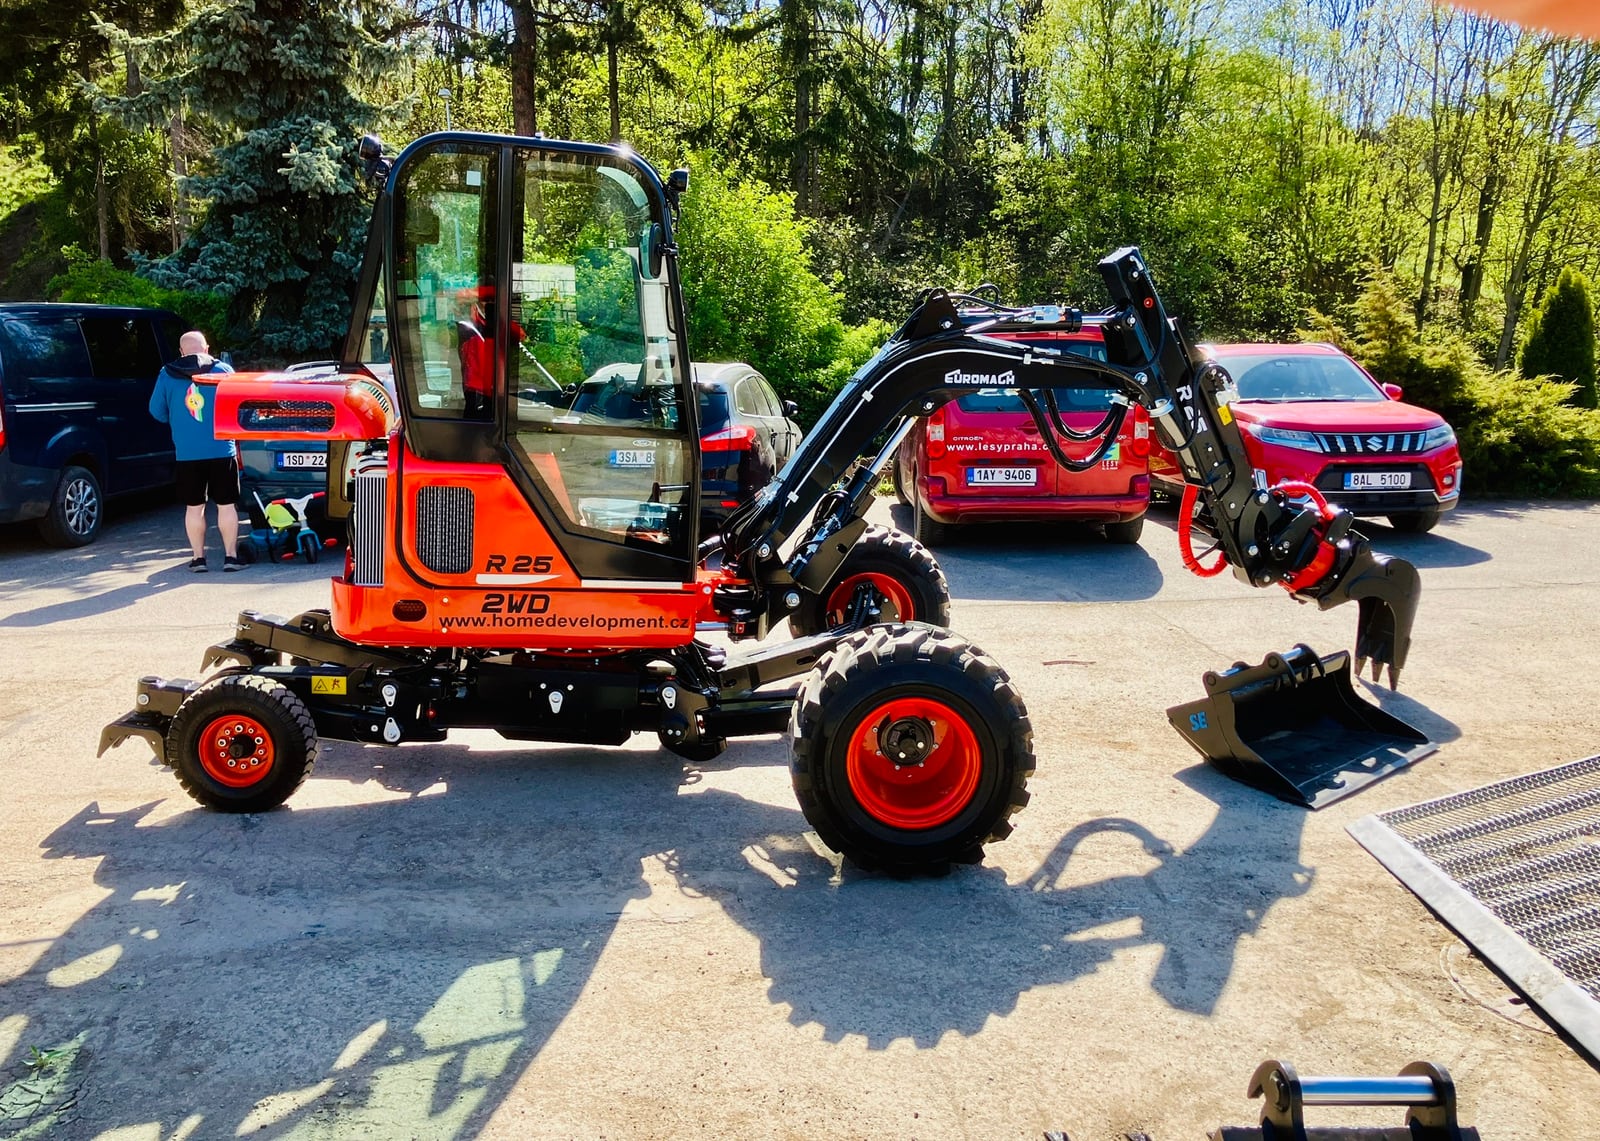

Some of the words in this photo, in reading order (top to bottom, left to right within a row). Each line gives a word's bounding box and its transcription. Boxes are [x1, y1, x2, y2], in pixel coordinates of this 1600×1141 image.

[945, 369, 1015, 385] EUROMACH
[1176, 385, 1193, 402] R
[946, 442, 1049, 453] www.lesypraha.c
[286, 455, 304, 466] 1SD
[618, 452, 638, 463] 3SA
[977, 470, 996, 481] 1AY
[1004, 469, 1032, 480] 9406
[1353, 474, 1372, 486] 8AL
[1380, 474, 1406, 485] 5100
[485, 554, 506, 573] R
[512, 555, 554, 573] 25
[481, 593, 551, 614] 2WD
[439, 613, 689, 629] www.homedevelopment.cz
